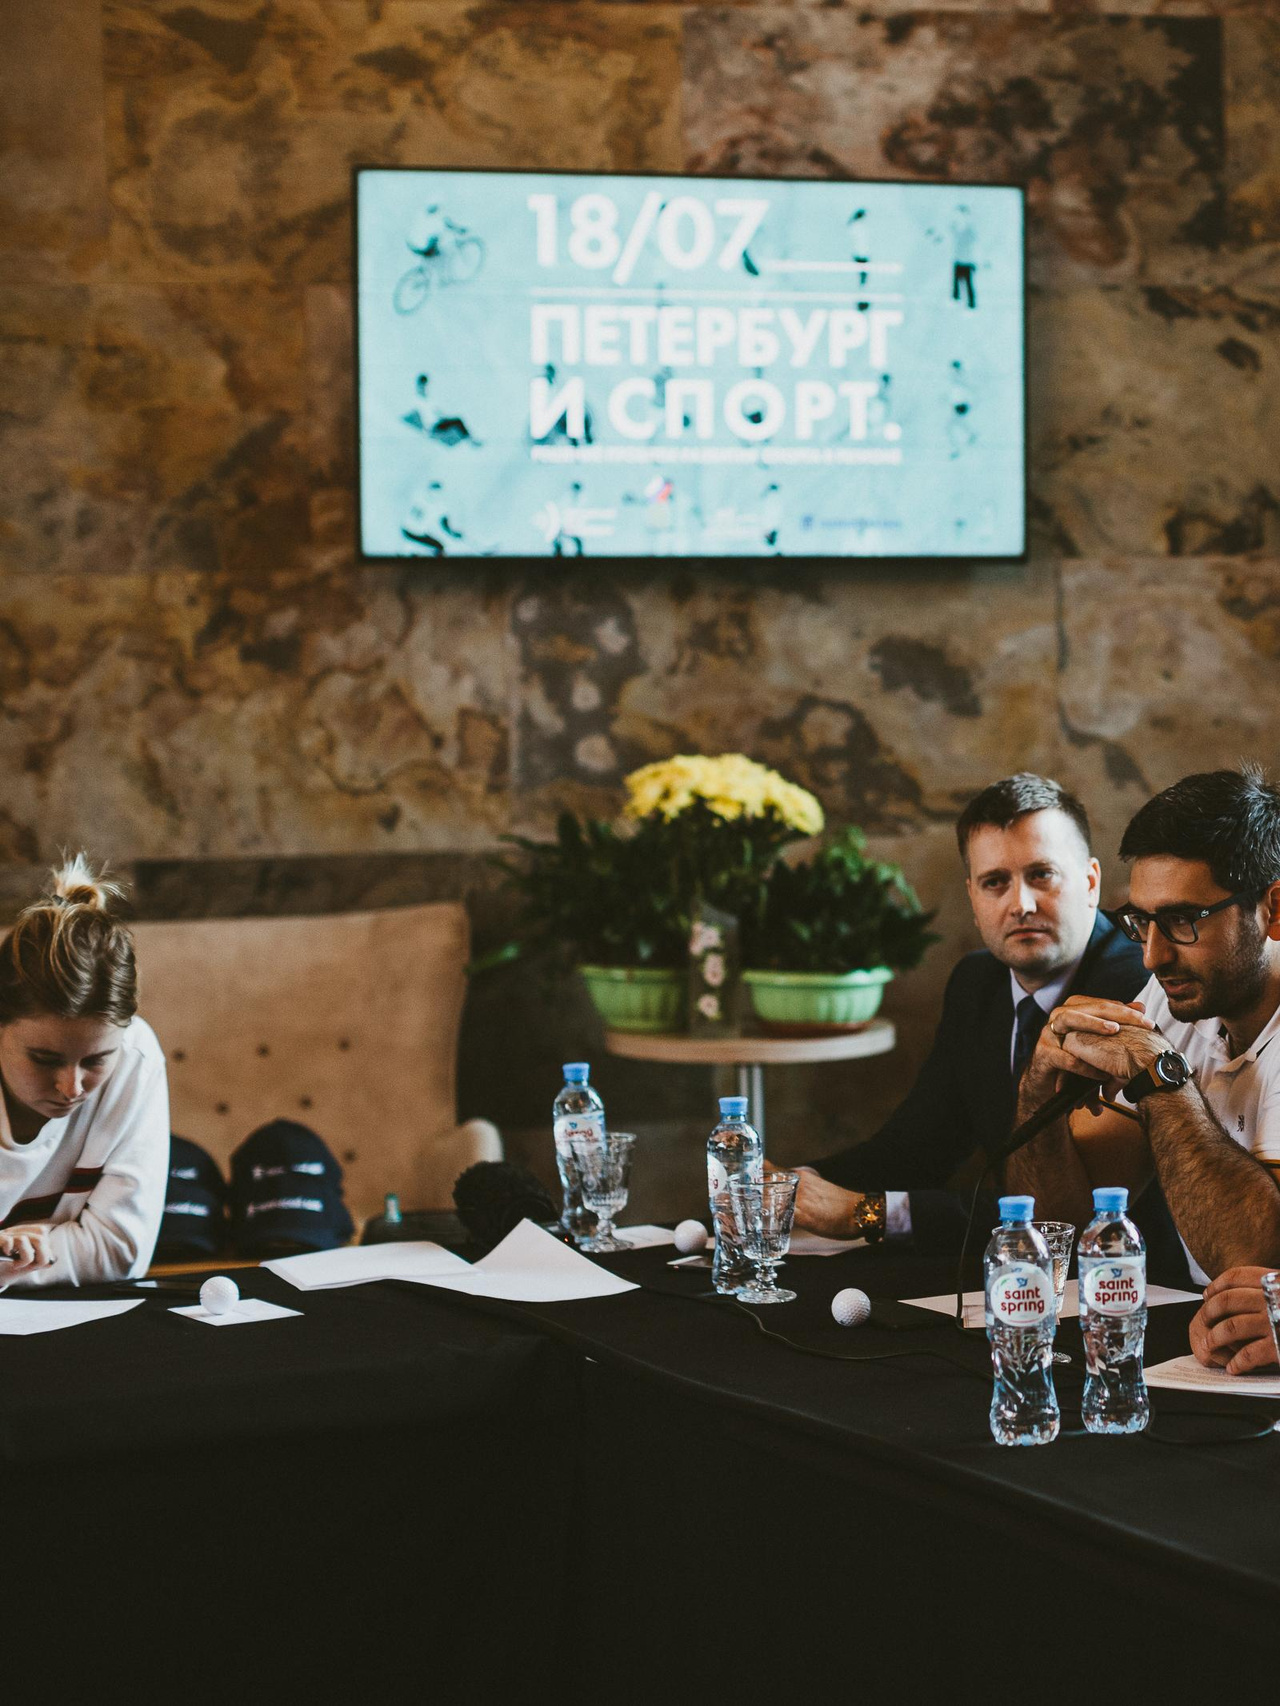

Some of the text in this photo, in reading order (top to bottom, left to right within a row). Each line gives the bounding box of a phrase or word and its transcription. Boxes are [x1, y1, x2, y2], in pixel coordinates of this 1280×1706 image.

[527, 192, 772, 284] 18/07
[529, 304, 902, 367] ПЕТЕРБУРГ
[529, 376, 902, 441] И СПОРТ.
[1098, 1276, 1135, 1290] saint
[1004, 1286, 1042, 1300] saint
[1094, 1289, 1139, 1305] spring
[1000, 1299, 1046, 1315] spring
